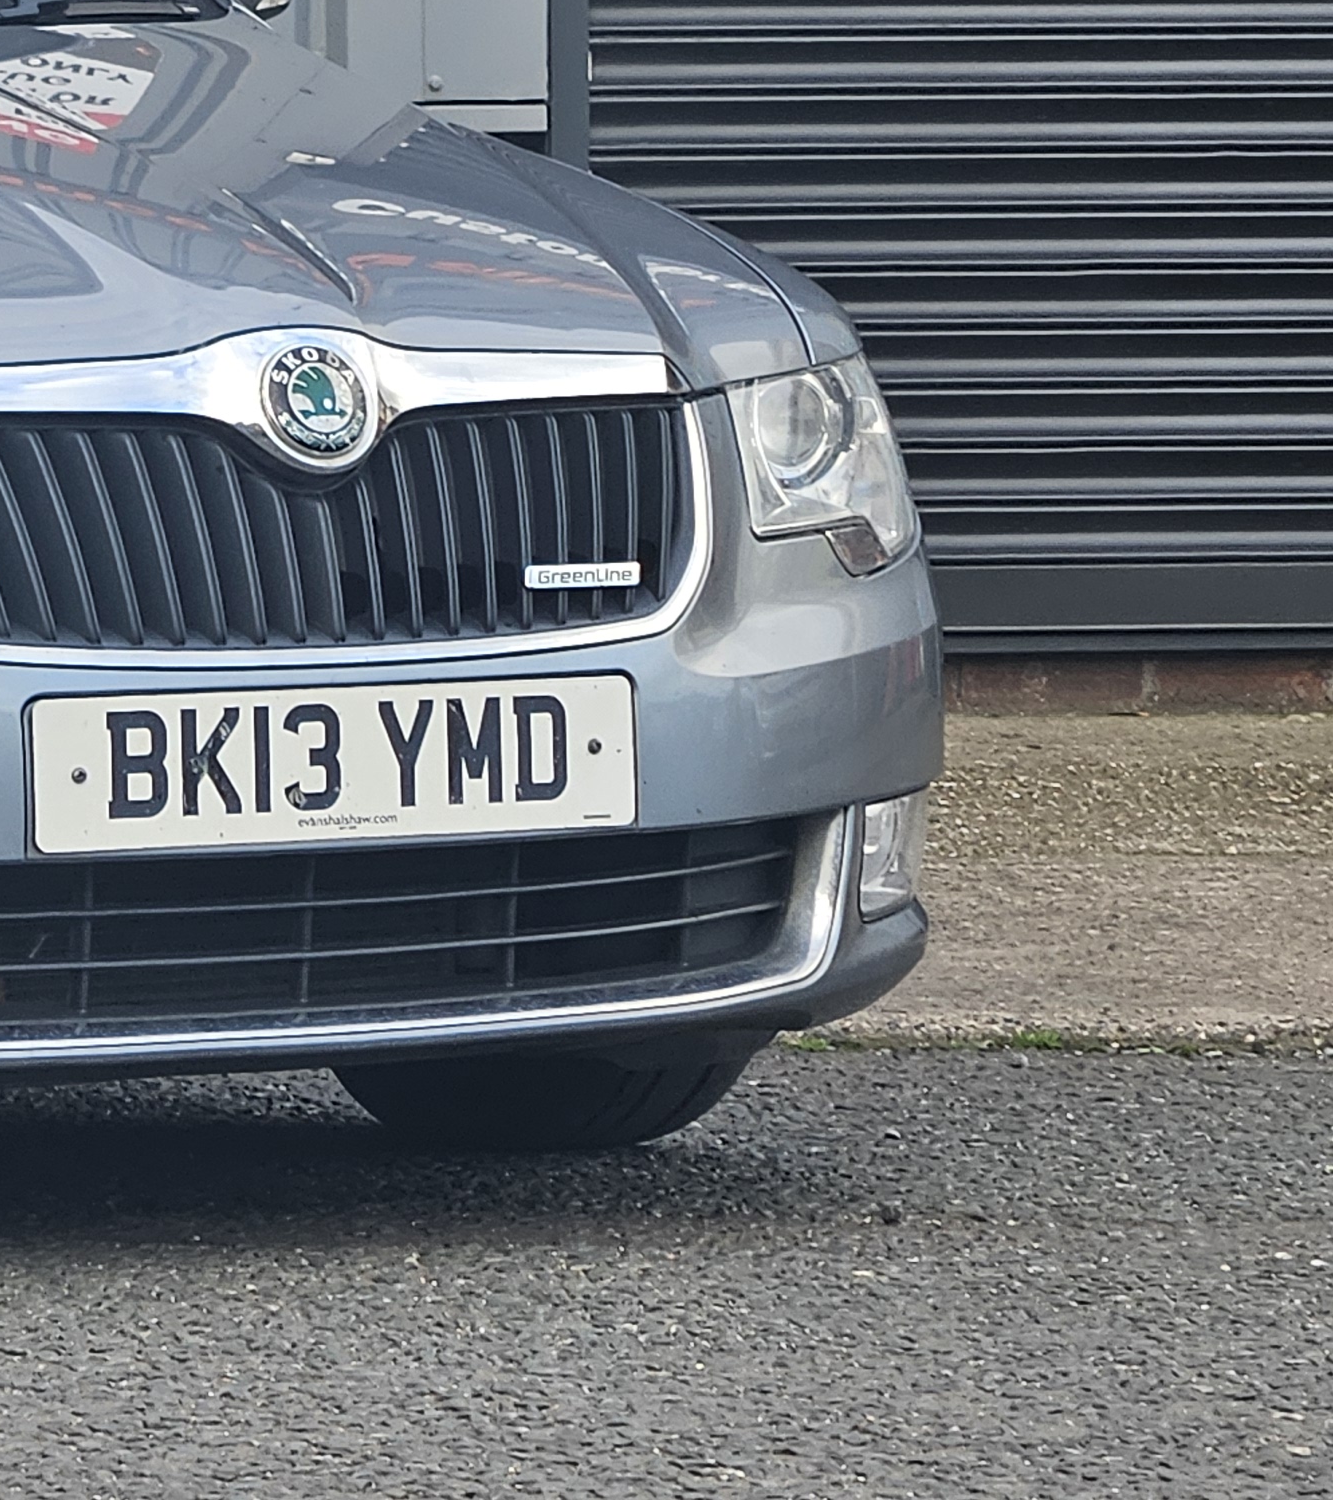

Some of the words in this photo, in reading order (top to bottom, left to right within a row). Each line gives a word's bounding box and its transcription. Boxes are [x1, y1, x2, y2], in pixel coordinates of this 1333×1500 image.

[538, 567, 632, 585] GreenLine
[106, 703, 342, 819] BK13
[378, 695, 569, 808] YMD
